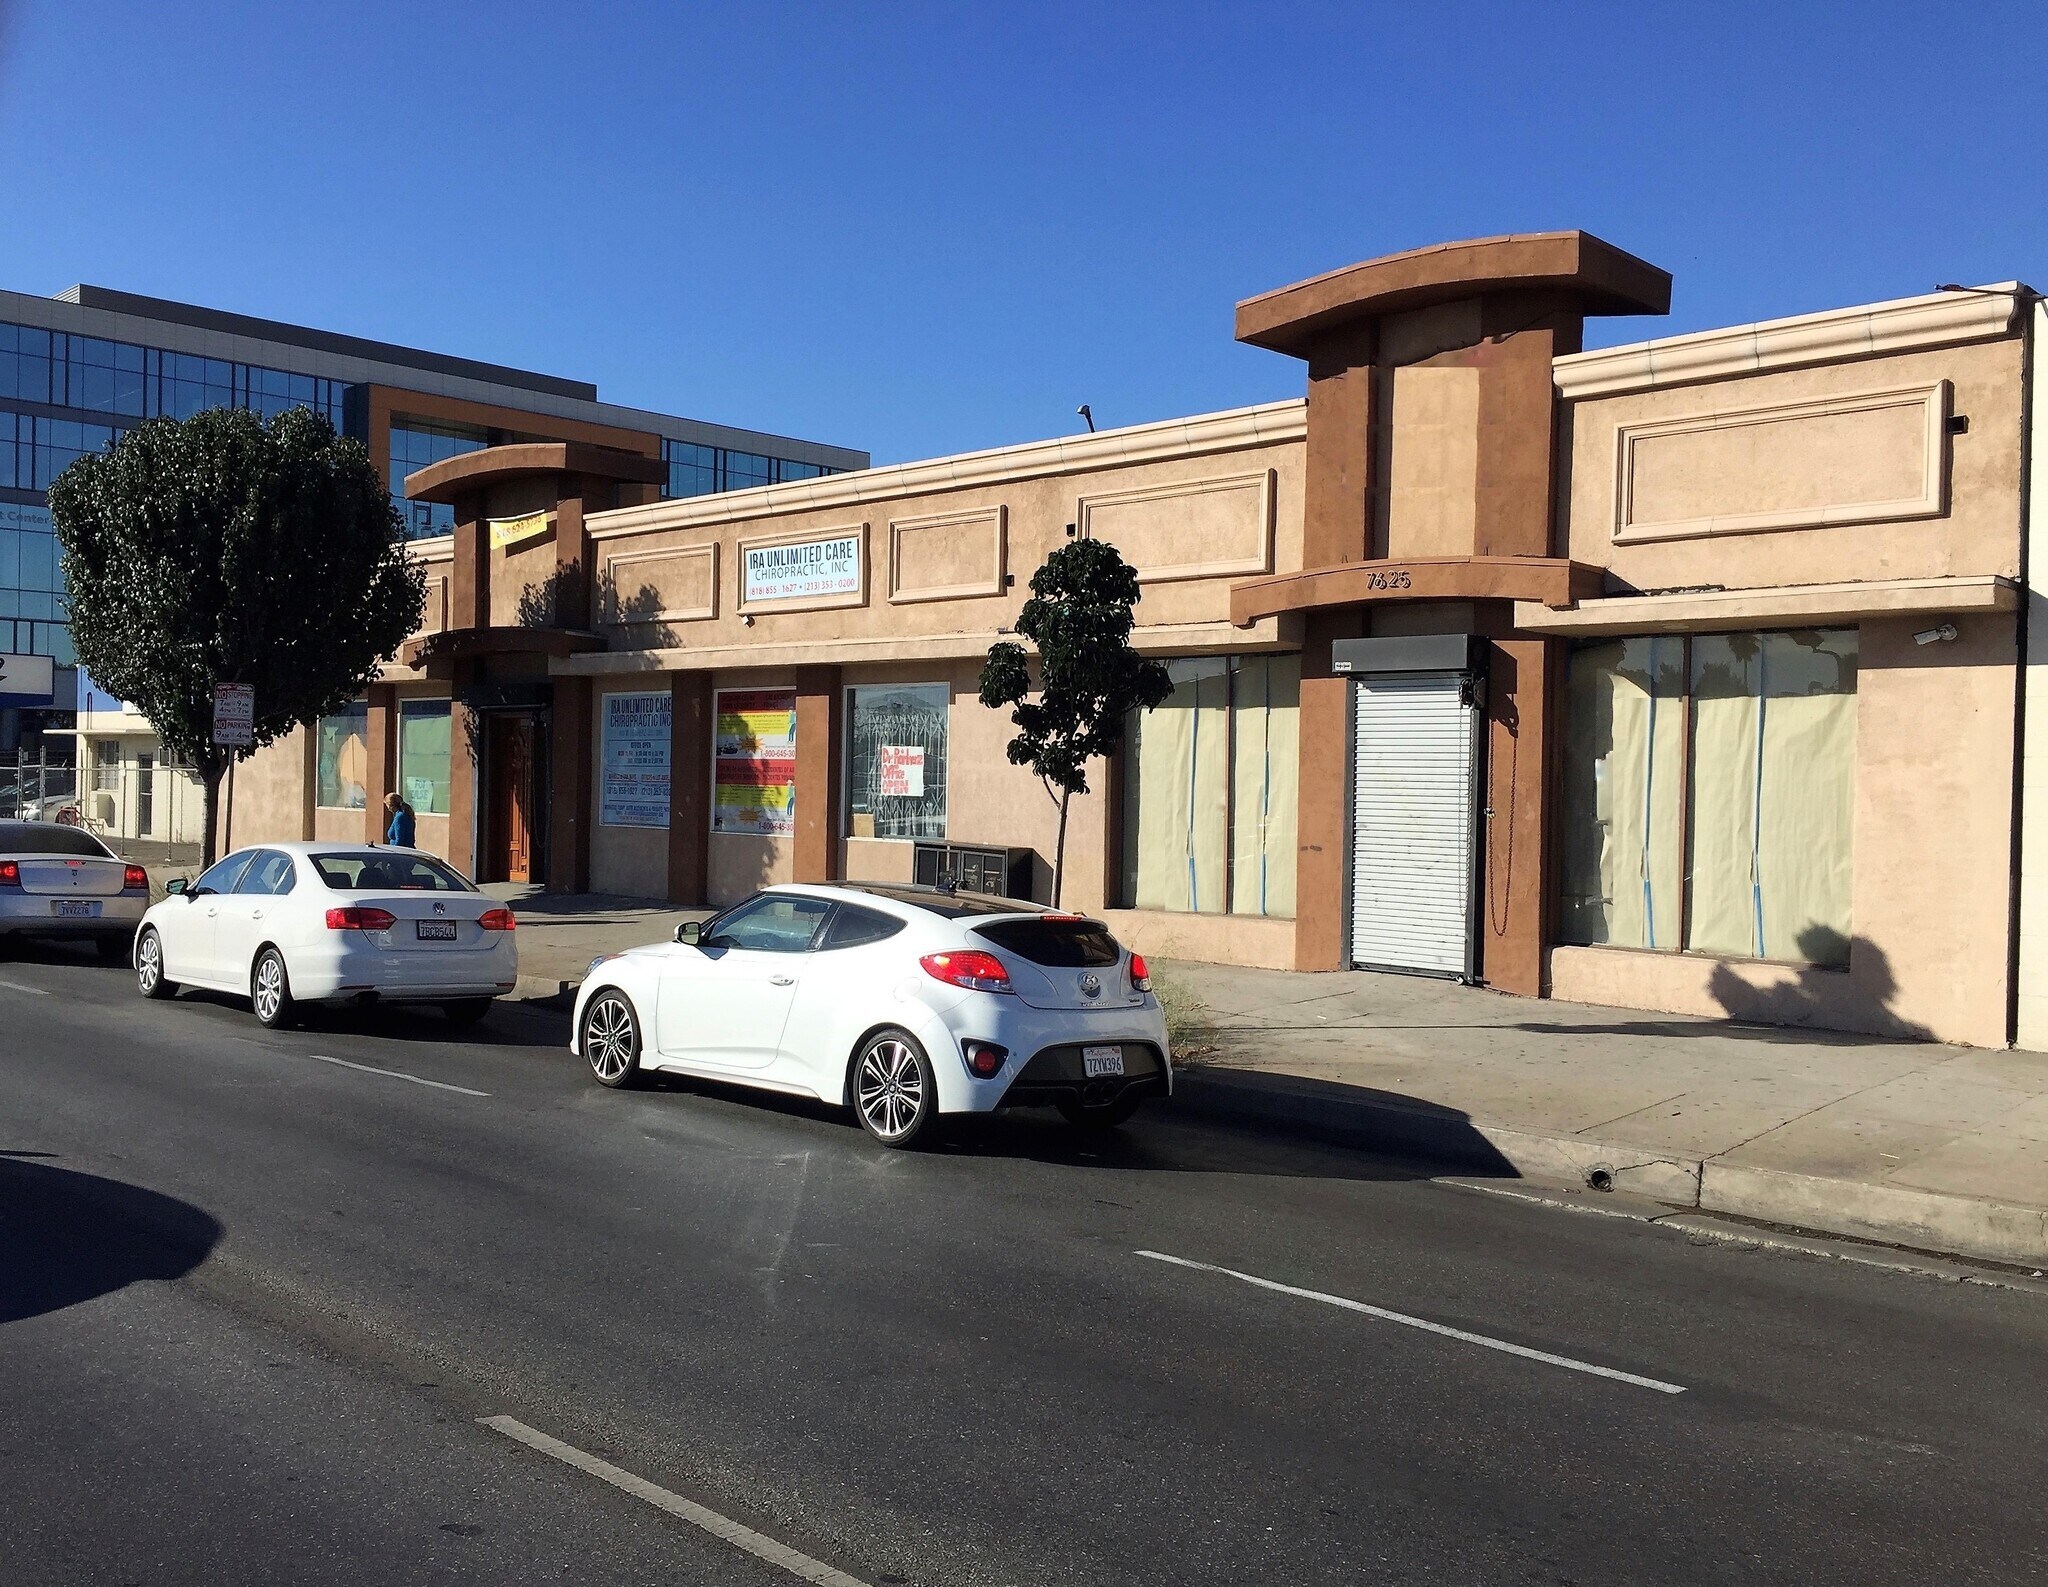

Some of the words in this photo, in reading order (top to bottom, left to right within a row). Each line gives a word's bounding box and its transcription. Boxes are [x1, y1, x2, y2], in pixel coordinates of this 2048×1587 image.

[7, 511, 51, 524] Center
[750, 553, 765, 570] IRA
[767, 545, 822, 567] UNLIMITED
[825, 541, 853, 560] CARE
[754, 563, 828, 581] CHIROPRACTIC,
[831, 560, 849, 573] INC
[782, 583, 797, 593] 1627
[821, 580, 834, 590] 353
[838, 578, 856, 588] 0200
[1366, 570, 1412, 590] 7625
[216, 690, 227, 699] NO
[621, 698, 654, 714] UNLIMITED
[655, 697, 672, 713] CARE
[215, 720, 226, 729] NO
[227, 721, 251, 730] PARKING
[610, 713, 659, 728] CHIROPRACTIC
[659, 713, 672, 727] INC
[882, 779, 909, 794] OPEN
